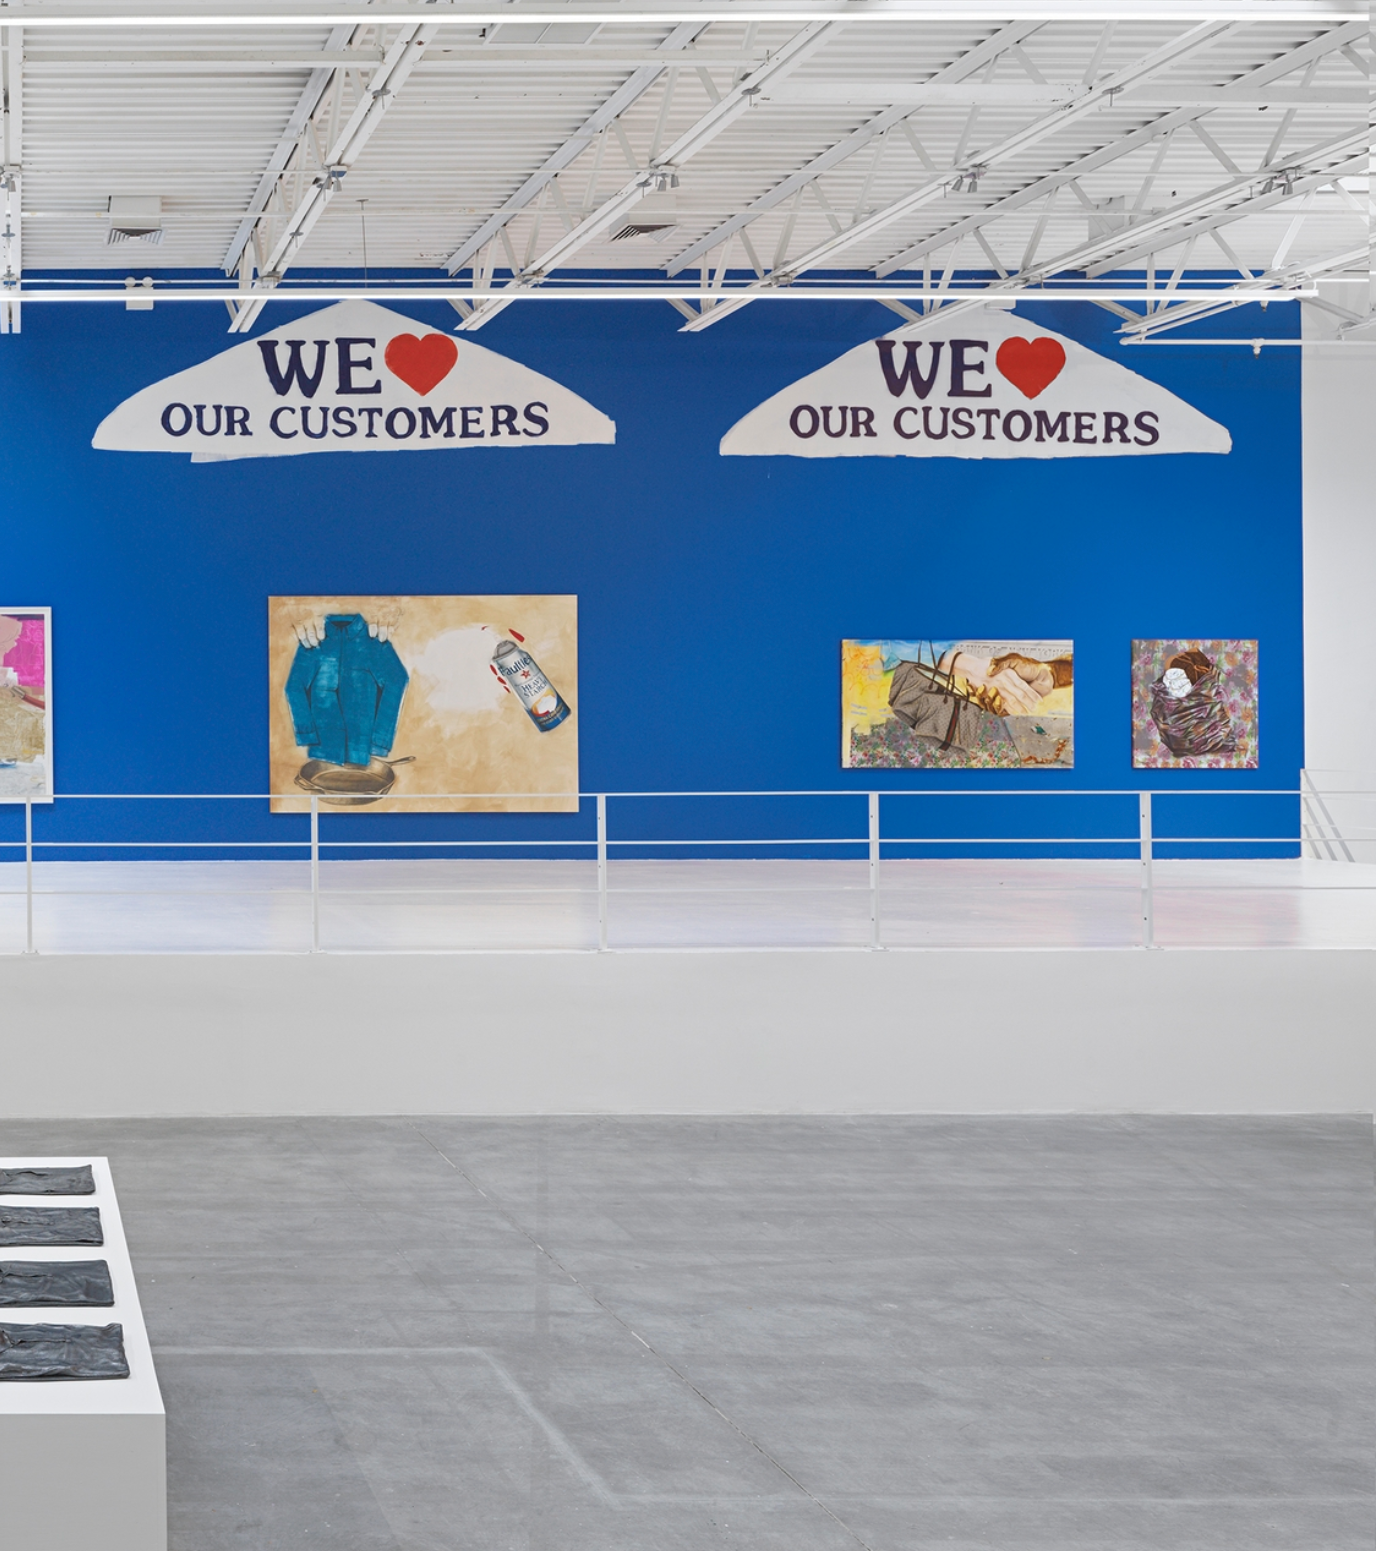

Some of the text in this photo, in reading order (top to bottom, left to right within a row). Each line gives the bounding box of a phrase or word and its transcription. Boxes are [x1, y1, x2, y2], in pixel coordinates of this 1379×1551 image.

[257, 338, 381, 398] WE
[876, 339, 991, 399] WE
[161, 402, 548, 439] OUR CUSTOMERS
[790, 405, 1159, 446] OUR CUSTOMERS
